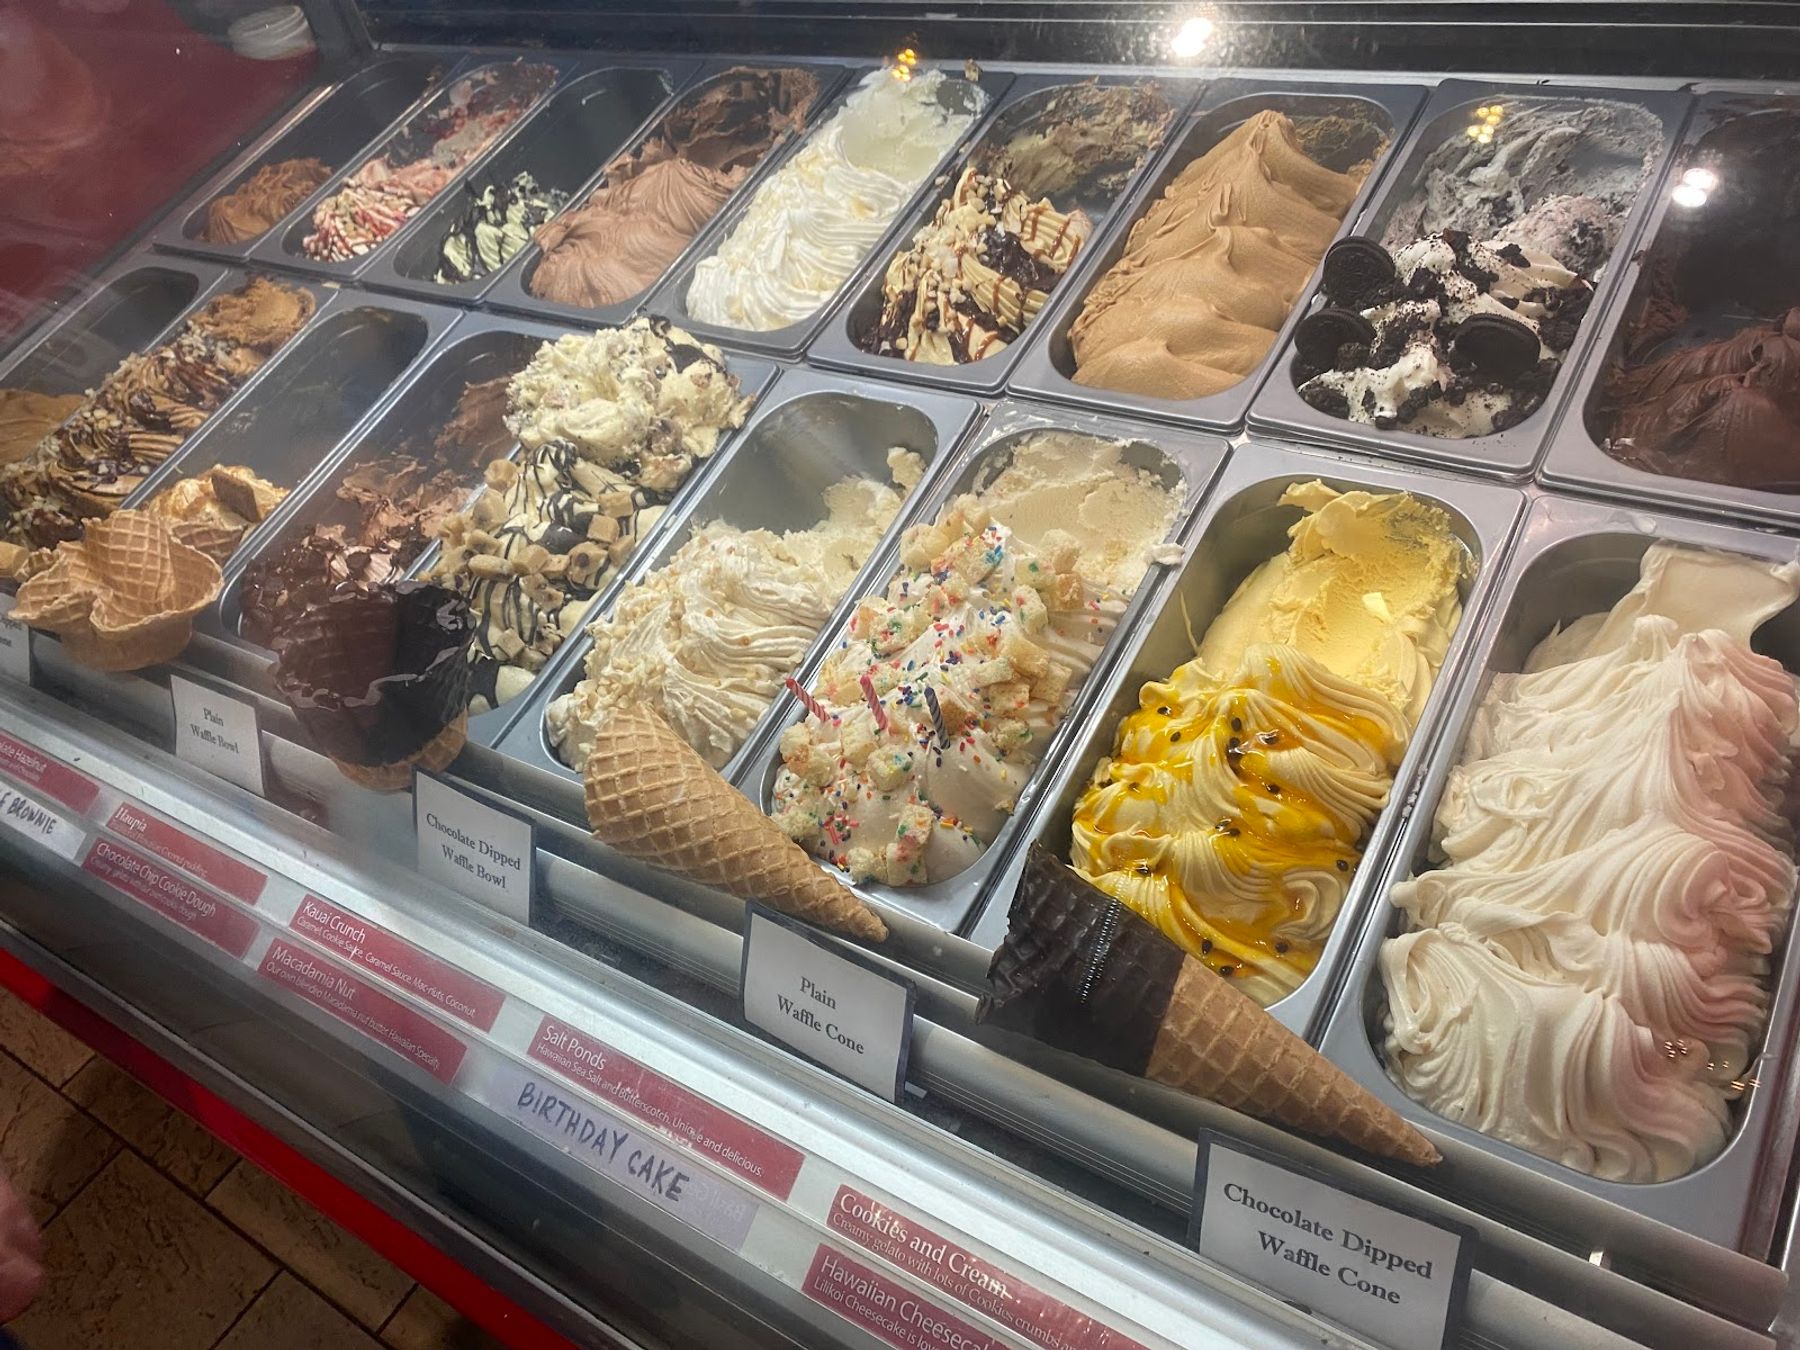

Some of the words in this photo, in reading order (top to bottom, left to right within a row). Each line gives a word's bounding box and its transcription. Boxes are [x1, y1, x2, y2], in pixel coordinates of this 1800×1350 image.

[190, 724, 216, 744] Waffle
[218, 735, 239, 753] Bowl
[203, 707, 224, 726] Plain
[7, 797, 57, 834] BROWNIE
[115, 807, 147, 832] Haupia
[427, 813, 475, 849] Chocolate
[479, 840, 520, 870] Dipped
[96, 843, 141, 873] Chocolate
[139, 865, 160, 886] Chip
[159, 876, 187, 900] Cookie
[186, 890, 217, 917] Dough
[442, 844, 474, 873] Waffle
[477, 864, 506, 888] Bowl
[303, 901, 332, 924] Kauai
[330, 916, 366, 944] Crunch
[272, 946, 334, 989] Macadamia
[334, 978, 356, 1001] Nut
[800, 976, 836, 1009] Plain
[445, 994, 476, 1018] Coconut
[777, 994, 821, 1031] Waffle
[826, 1023, 864, 1054] Cone
[543, 1025, 567, 1049] Salt
[566, 1038, 606, 1070] Ponds
[536, 1043, 572, 1068] Hawaiian
[571, 1062, 587, 1077] Sea
[586, 1069, 602, 1086] Salt
[601, 1081, 621, 1095] and
[703, 1137, 723, 1154] and
[721, 1146, 762, 1177] delicious.
[516, 1081, 629, 1164] BIRTHDAY
[627, 1149, 691, 1202] CAKE
[840, 1193, 908, 1243] Cookies
[909, 1236, 947, 1265] and
[948, 1252, 1009, 1300] Cream
[1223, 1182, 1334, 1242] Chocolate
[1340, 1228, 1433, 1279] Dipped
[833, 1212, 873, 1245] Creamy
[872, 1240, 906, 1261] gelato
[908, 1255, 932, 1278] with
[933, 1267, 954, 1288] lots
[954, 1281, 969, 1296] of
[968, 1288, 1014, 1322] Cookies
[1258, 1230, 1331, 1277] Waffle
[1337, 1266, 1401, 1305] Cone
[813, 1276, 846, 1303] Lilikoi
[844, 1293, 906, 1340] Cheesecake
[906, 1329, 918, 1345] is
[820, 1254, 897, 1313] Hawaiian
[899, 1300, 990, 1350] Cheesec
